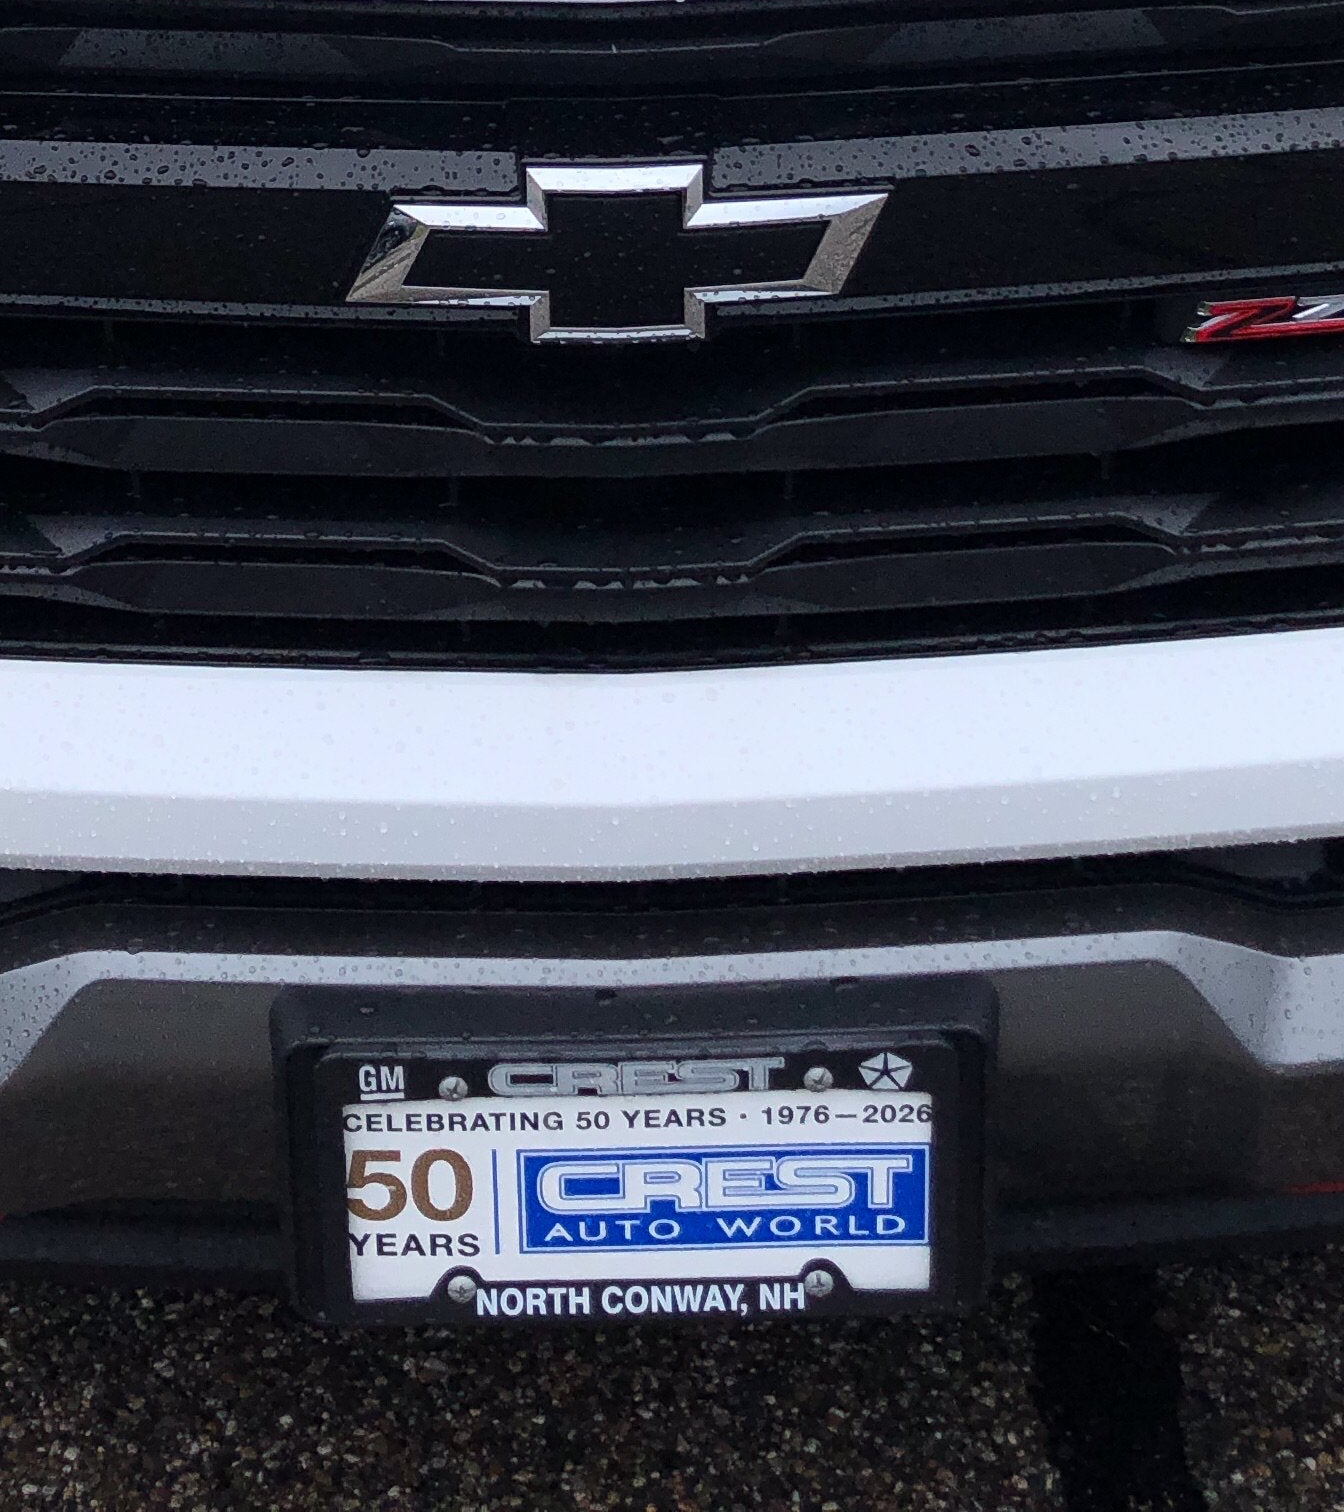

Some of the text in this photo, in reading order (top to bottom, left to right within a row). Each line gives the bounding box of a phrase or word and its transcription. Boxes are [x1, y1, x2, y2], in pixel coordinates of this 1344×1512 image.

[358, 1065, 405, 1092] GM
[488, 1056, 786, 1098] CREST
[342, 1111, 565, 1133] CELEBRATING
[575, 1110, 611, 1131] 50
[622, 1107, 727, 1129] YEARS
[346, 1148, 474, 1222] 50
[536, 1155, 913, 1216] CREST
[544, 1214, 906, 1242] AUTO WORLD
[348, 1232, 481, 1257] YEARS
[475, 1283, 806, 1317] NORTH CONWAY, NH
